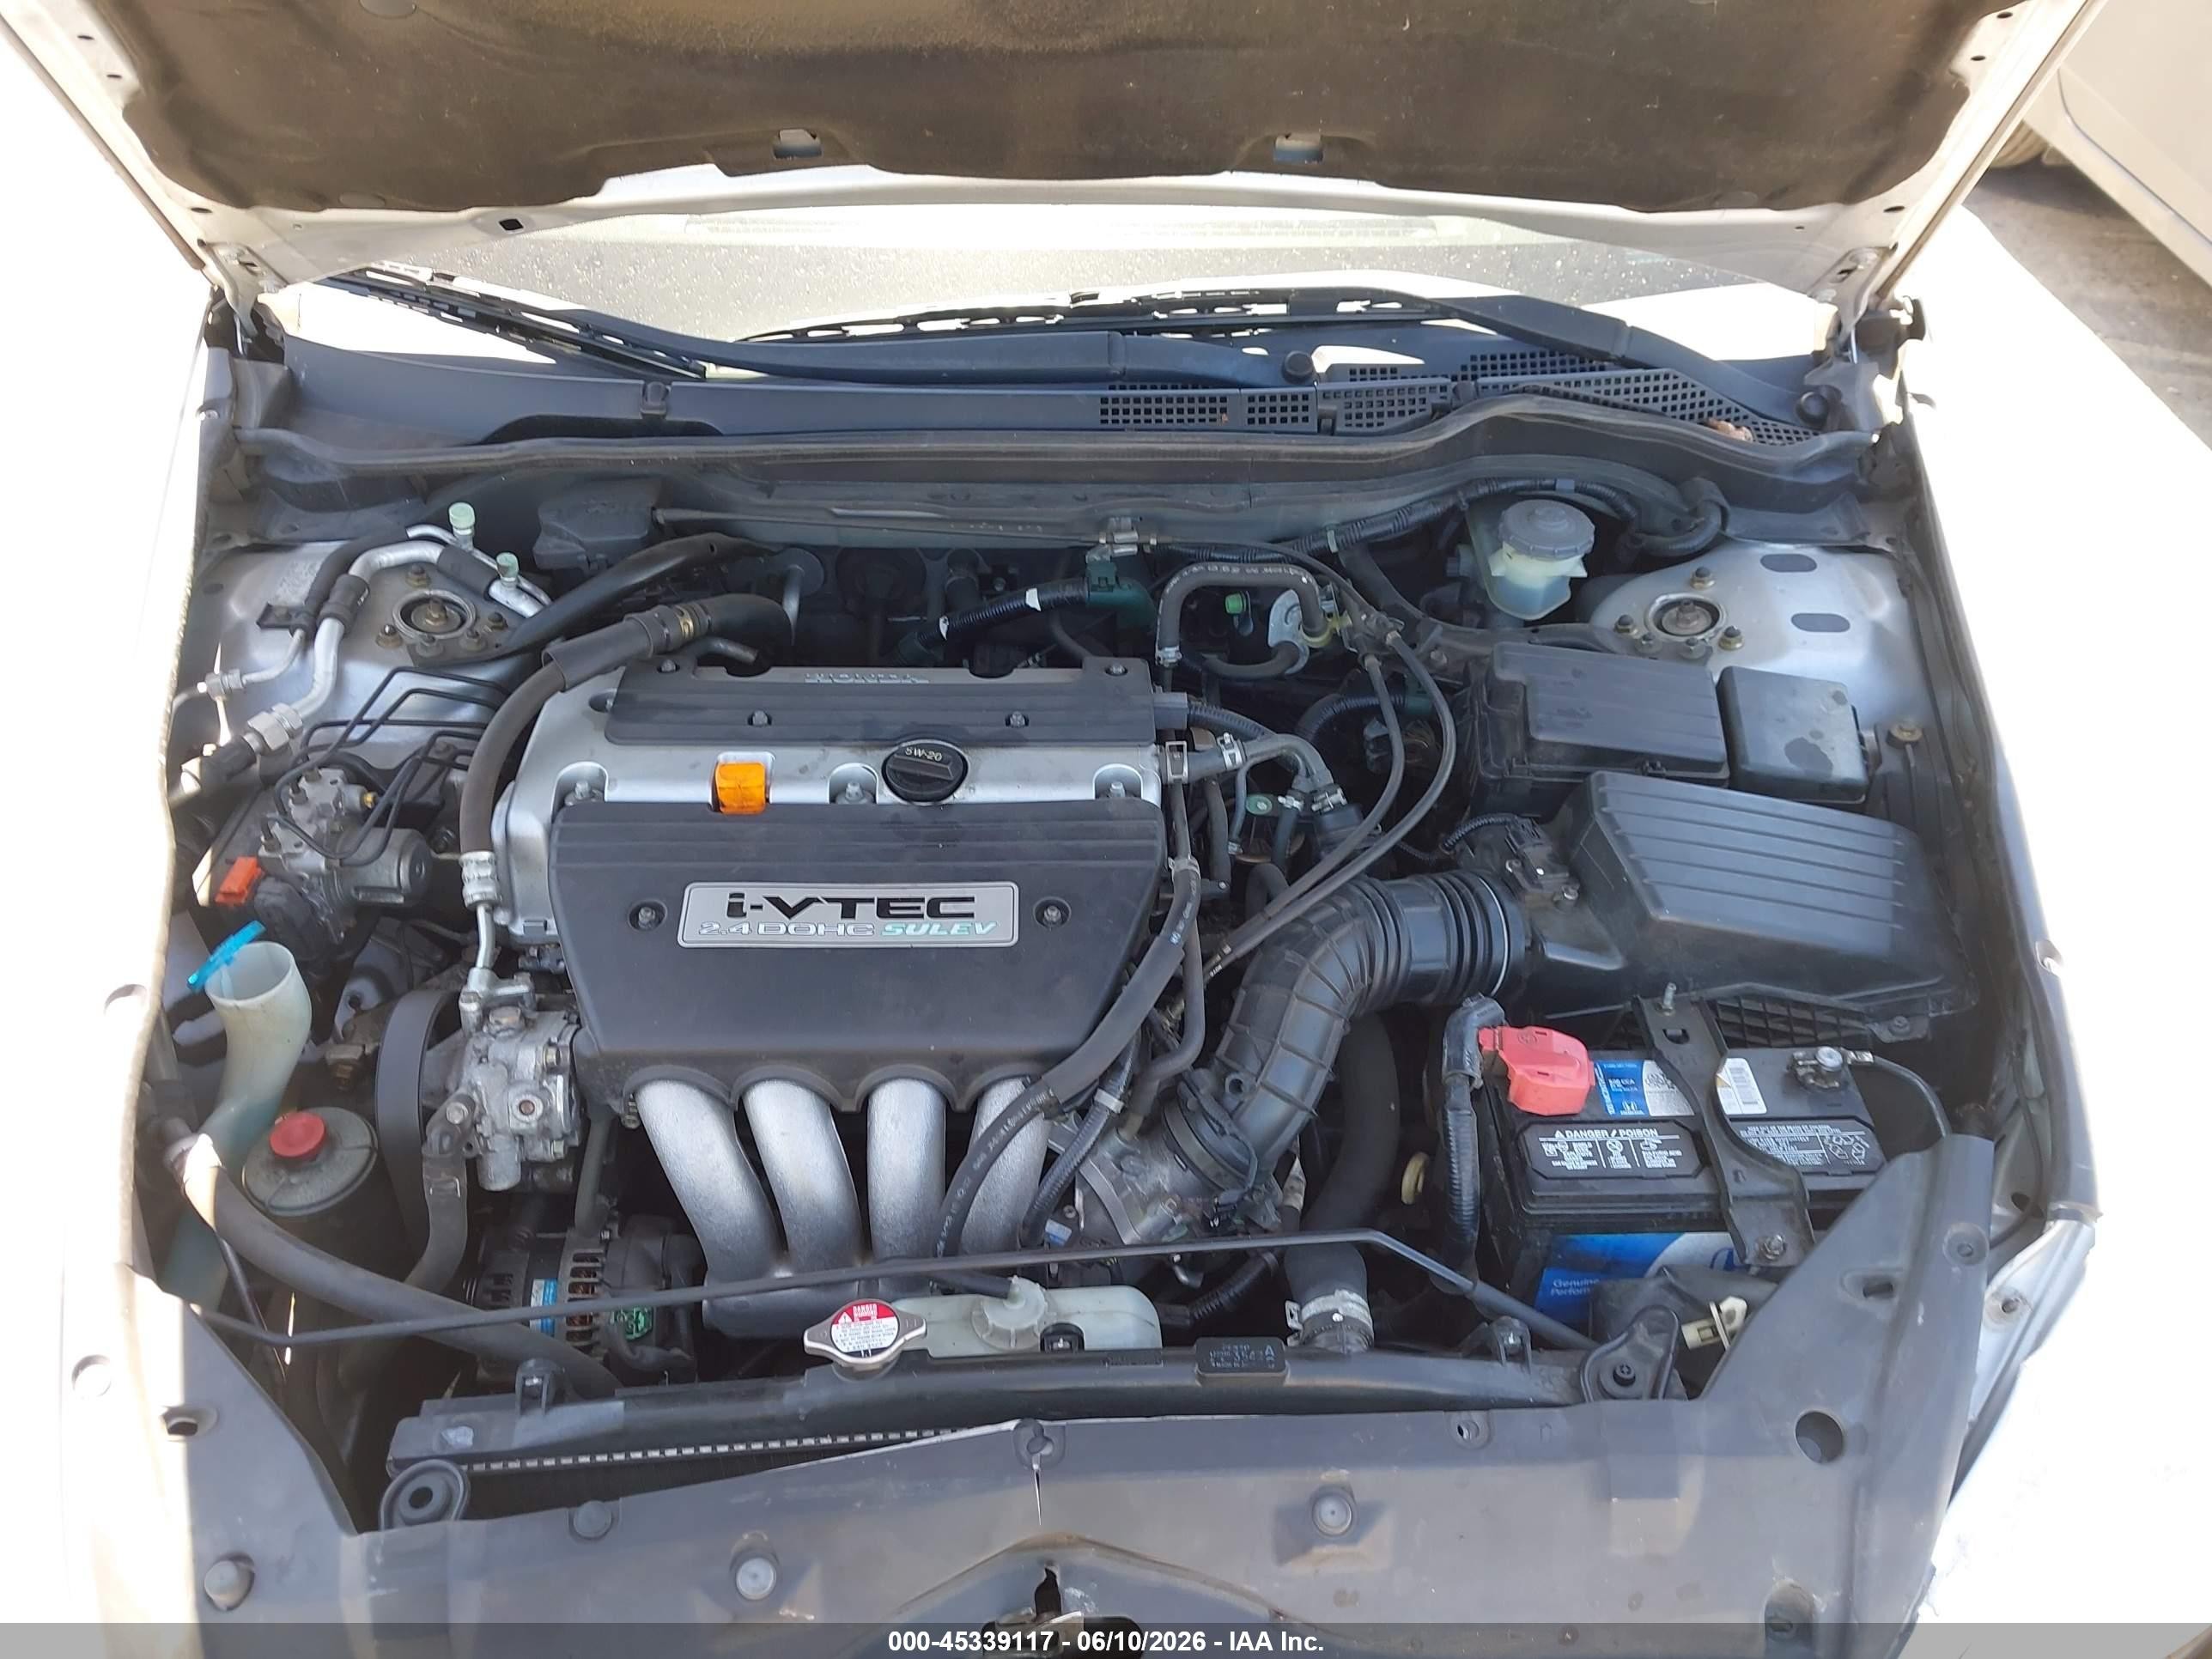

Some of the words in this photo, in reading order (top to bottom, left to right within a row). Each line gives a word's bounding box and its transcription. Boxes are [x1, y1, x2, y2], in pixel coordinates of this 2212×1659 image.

[904, 747, 944, 763] 5W-20
[726, 892, 976, 920] i-VTEC
[698, 921, 753, 936] 2.4
[757, 921, 875, 937] DOHC
[881, 921, 998, 936] SULEV
[1565, 1129, 1609, 1139] DANGER
[1619, 1128, 1659, 1138] POISON
[1553, 1278, 1601, 1288] Genuine
[1550, 1287, 1591, 1297] Perform
